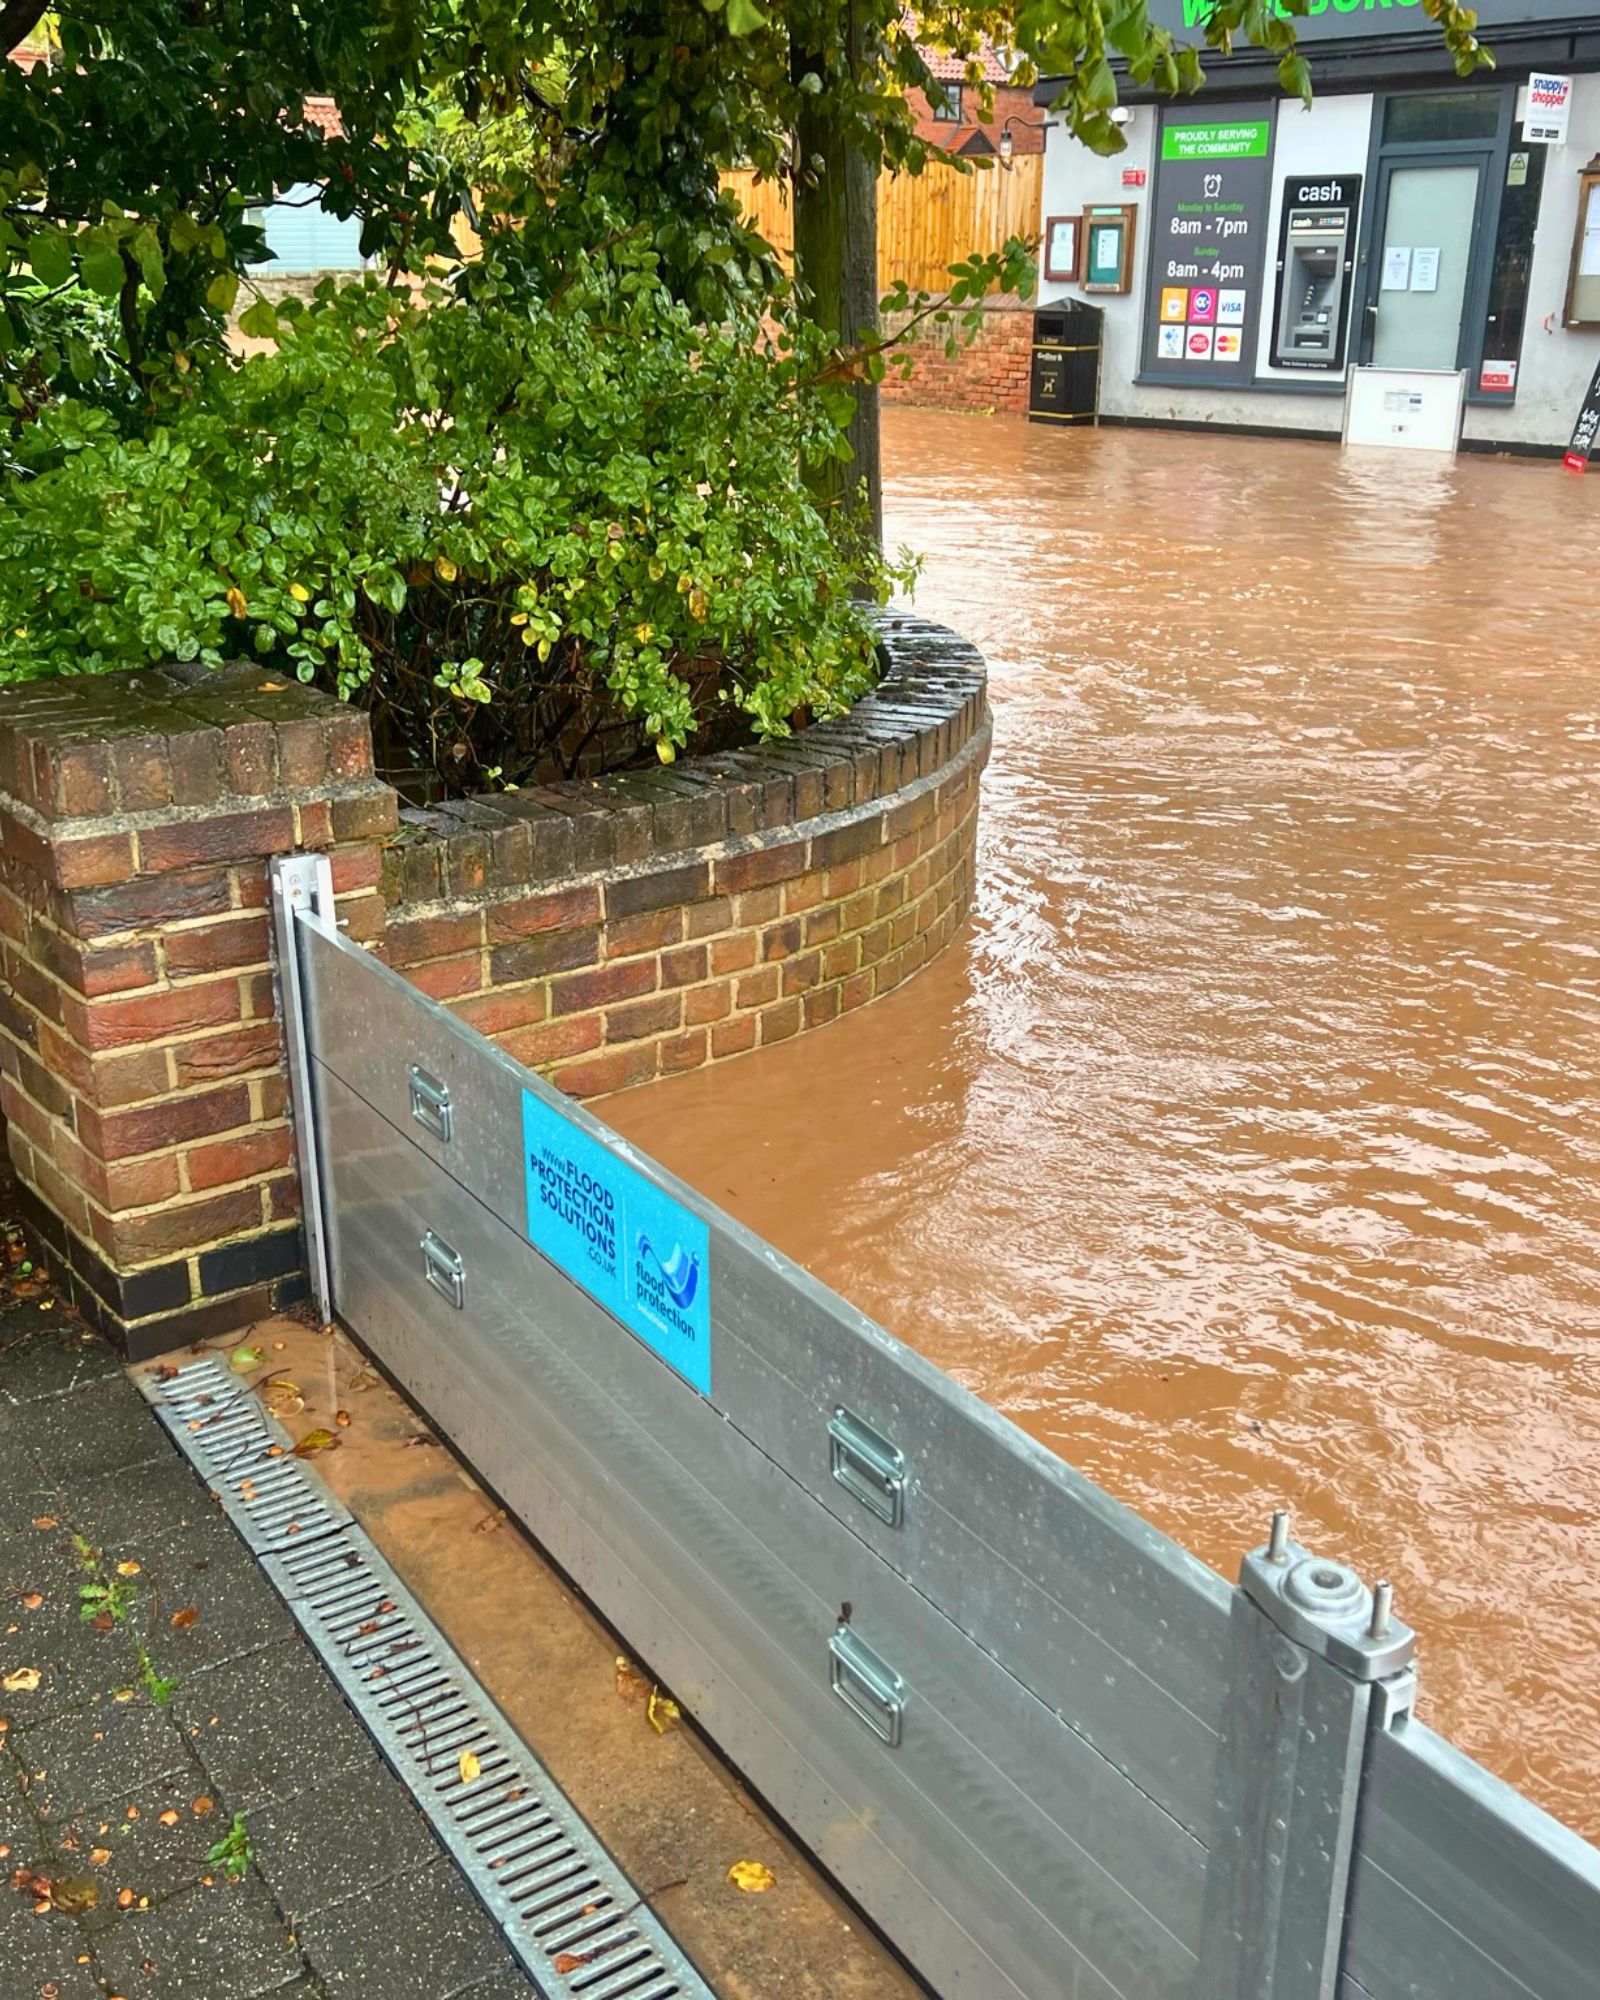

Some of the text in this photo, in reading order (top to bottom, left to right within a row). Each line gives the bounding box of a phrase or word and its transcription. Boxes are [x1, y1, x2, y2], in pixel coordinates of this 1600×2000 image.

[1533, 79, 1563, 95] snappy
[1532, 91, 1565, 108] shopper
[1174, 128, 1258, 142] PROUDLY SERVING
[1178, 141, 1252, 155] THE COMMUNITY
[1298, 180, 1342, 202] cash
[1177, 203, 1204, 213] Monday
[1213, 202, 1244, 213] Saturday
[1170, 217, 1202, 234] 8am
[1215, 216, 1248, 238] 7pm
[1193, 246, 1220, 257] Sunday
[1167, 260, 1198, 277] 8am
[1210, 261, 1244, 282] 4pm
[1221, 303, 1242, 312] VISA
[531, 1153, 616, 1237] PROTECTION
[540, 1183, 616, 1260] SOLUTIONS
[636, 1261, 665, 1295] flood
[636, 1281, 696, 1342] protection
